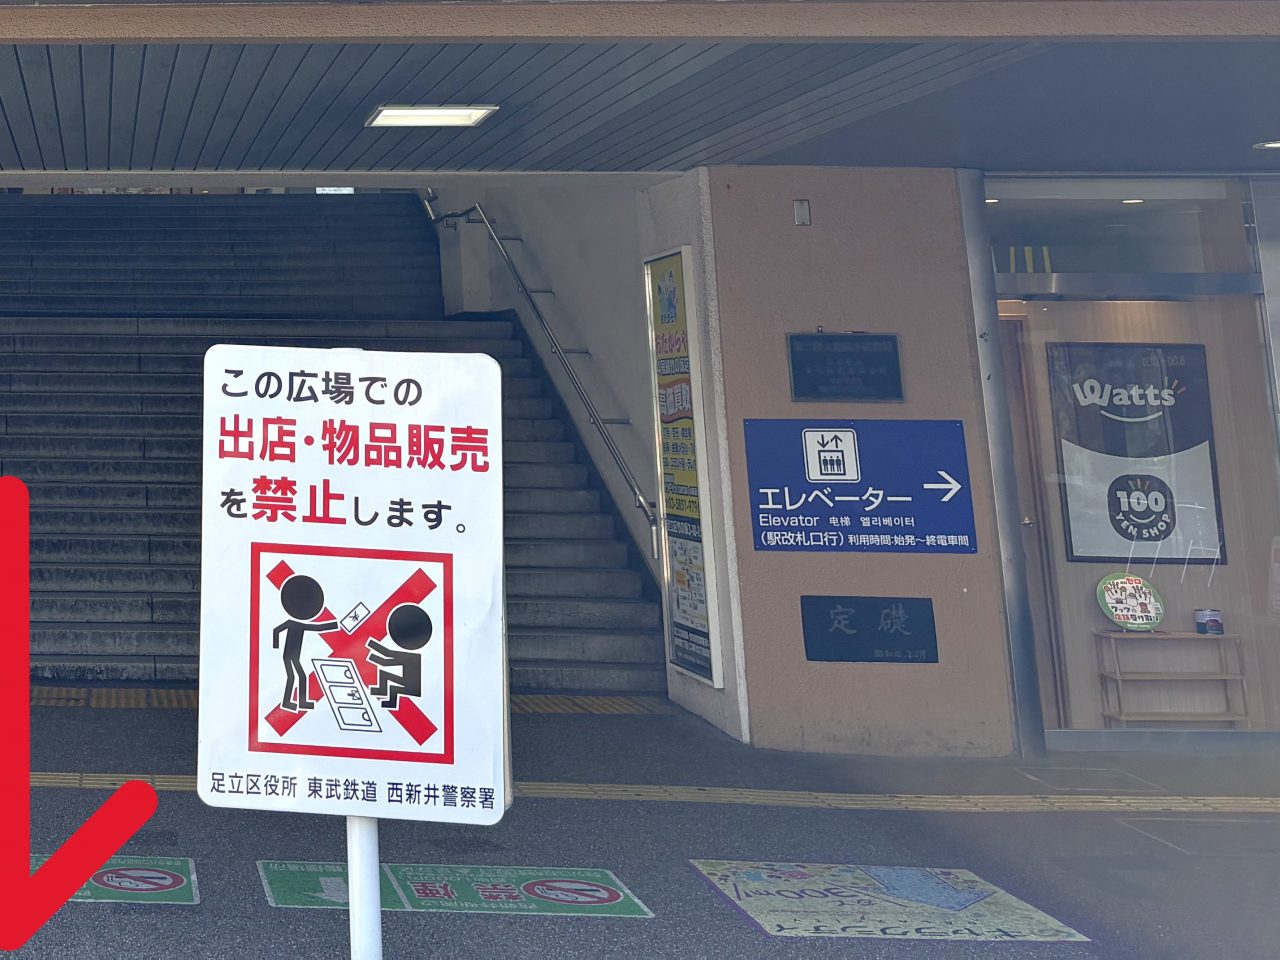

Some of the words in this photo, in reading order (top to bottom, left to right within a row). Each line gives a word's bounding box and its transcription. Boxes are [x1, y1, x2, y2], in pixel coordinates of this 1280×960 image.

[221, 369, 423, 407] この広場での
[1072, 378, 1176, 407] Watts
[218, 414, 490, 473] 出店・物品販売
[220, 475, 467, 534] を禁止します。
[759, 486, 913, 512] エレベーター
[1116, 490, 1166, 513] 100
[759, 513, 820, 527] Elevator
[859, 516, 916, 527] 엘리베이터
[1114, 512, 1139, 537] YEN
[1142, 513, 1171, 538] SHOP
[760, 530, 844, 547] （駅改札口行）
[210, 772, 298, 798] 足立区役所
[307, 777, 378, 803] 東武鉄道
[386, 782, 496, 810] 西新井警察署
[406, 880, 524, 902] 禁煙
